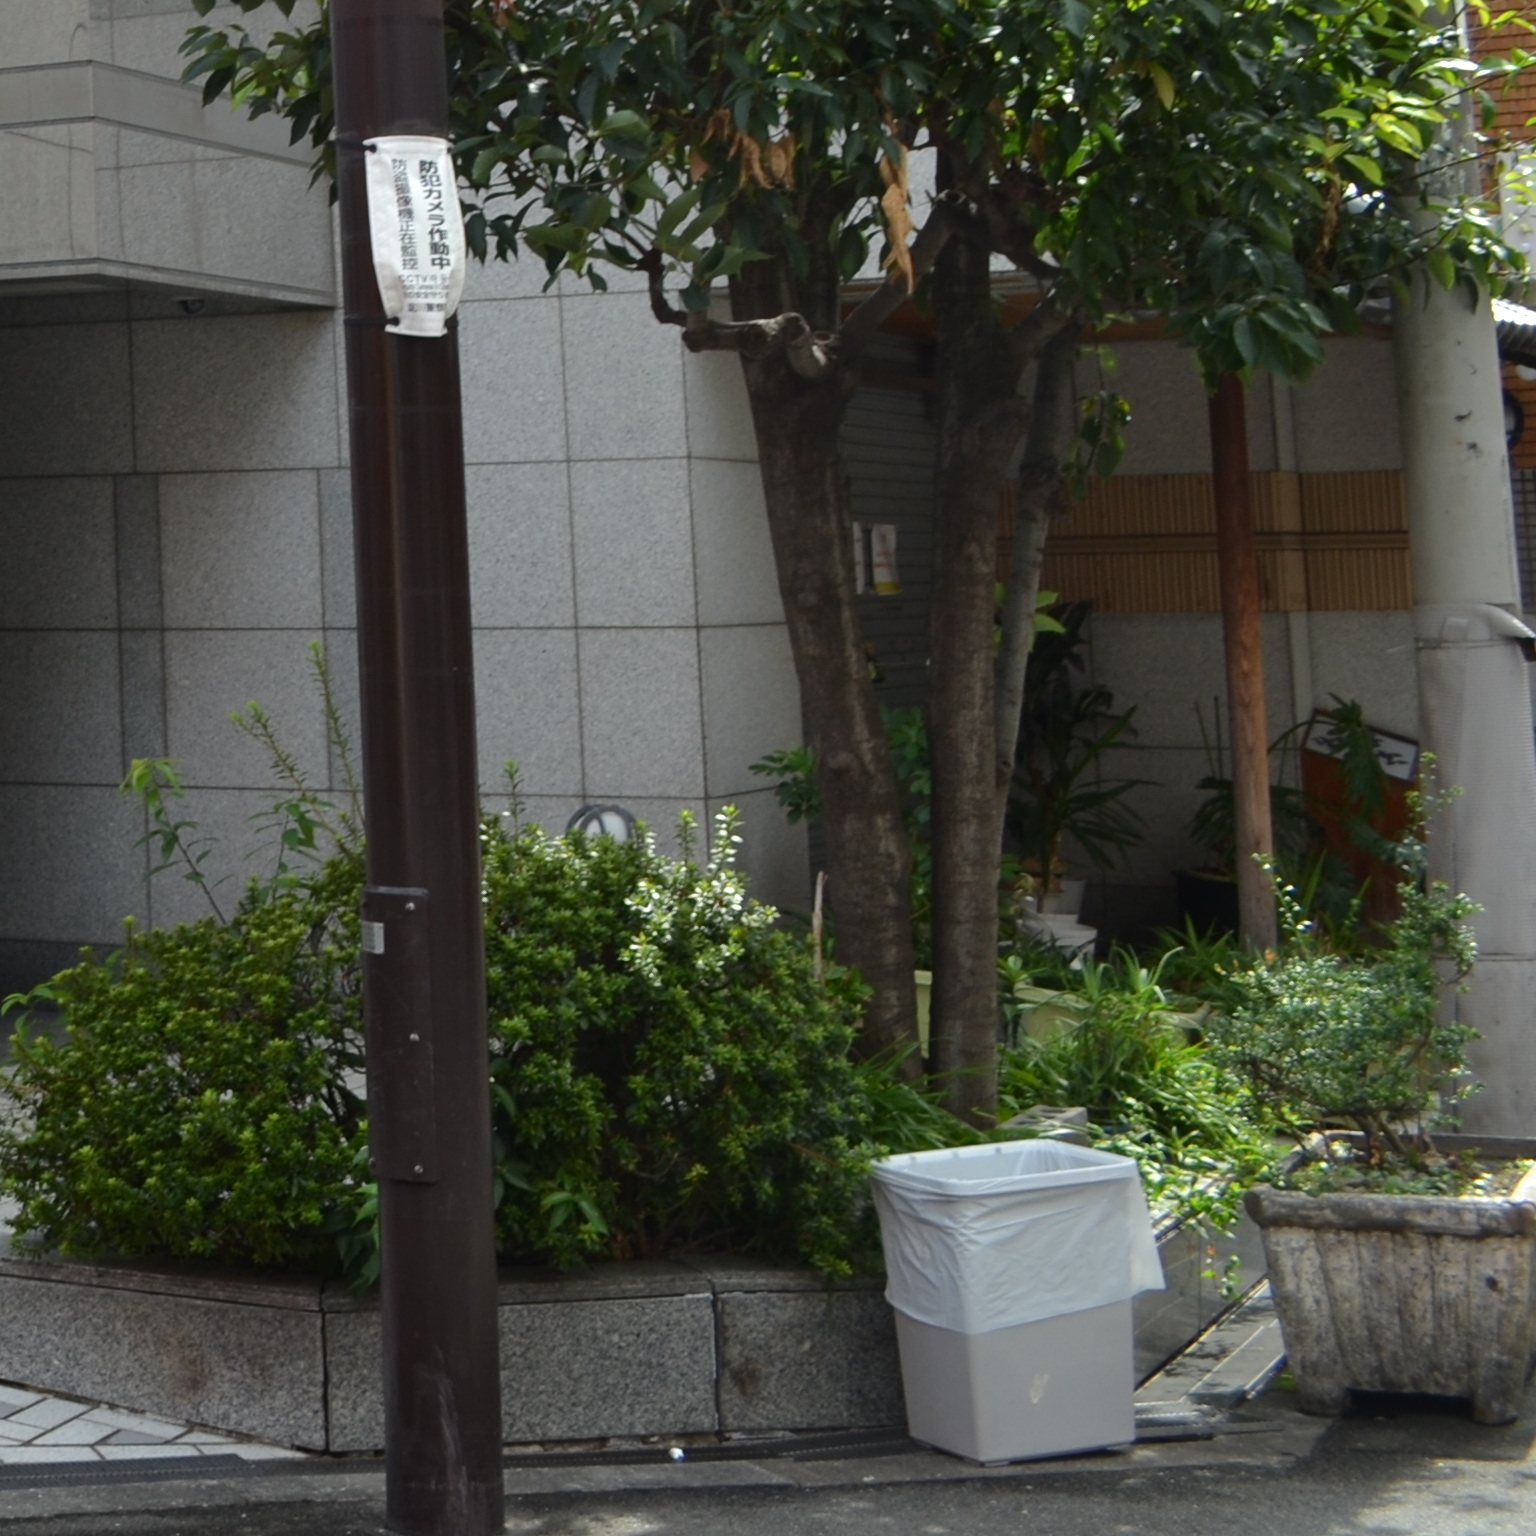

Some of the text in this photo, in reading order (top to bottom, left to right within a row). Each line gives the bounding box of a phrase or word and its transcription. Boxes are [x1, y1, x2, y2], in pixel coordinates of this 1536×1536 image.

[418, 159, 451, 271] 防犯カメラ作動中
